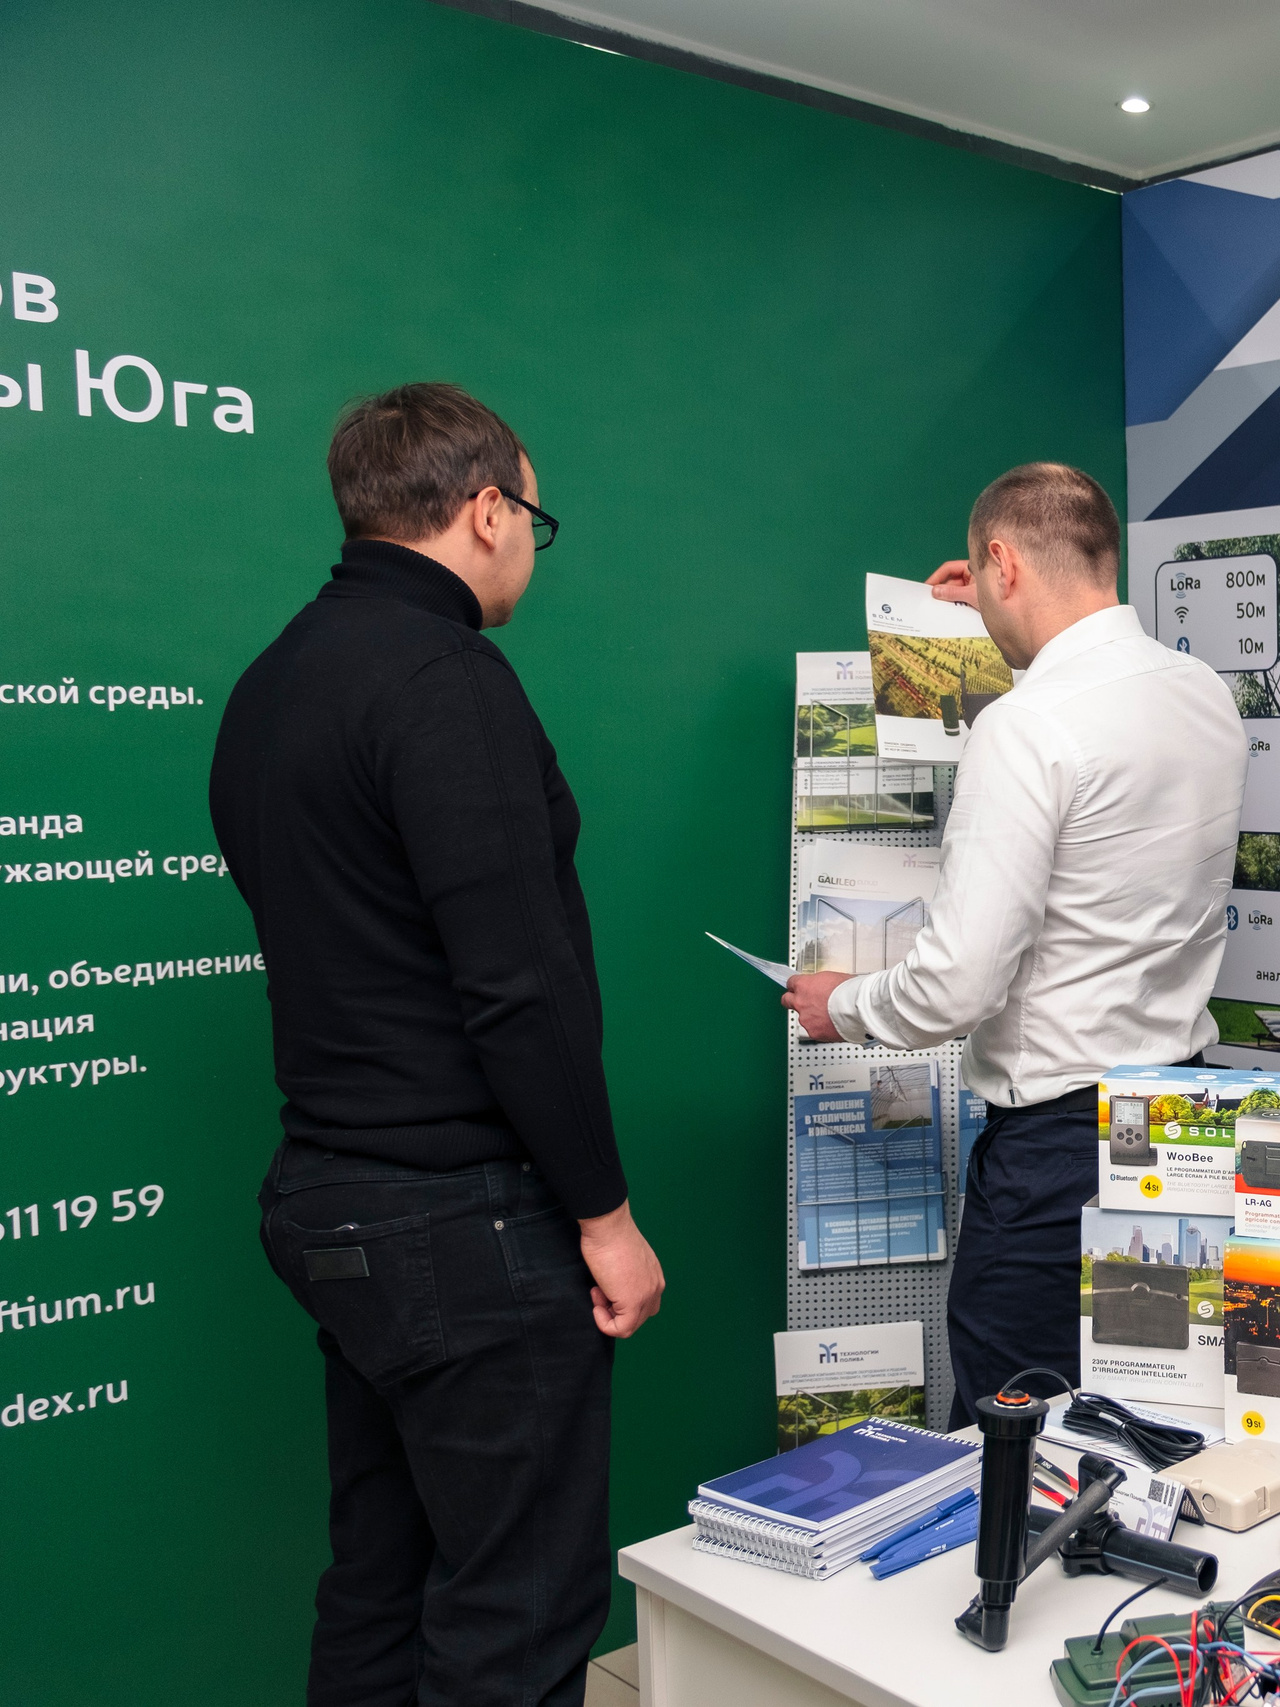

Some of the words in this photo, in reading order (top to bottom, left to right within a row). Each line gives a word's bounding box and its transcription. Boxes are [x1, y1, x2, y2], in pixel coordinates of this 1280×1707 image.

[76, 349, 254, 434] Юга
[1171, 576, 1200, 591] LoRa
[1226, 570, 1266, 588] 800м
[1236, 602, 1265, 619] 50м
[1238, 638, 1264, 654] 10м
[0, 677, 79, 705] ской
[89, 683, 204, 711] среды.
[0, 813, 83, 840] анда
[0, 850, 153, 883] жающей
[818, 875, 856, 887] GALILEO
[1248, 914, 1273, 925] LoRa
[48, 952, 267, 989] объединение
[818, 1099, 865, 1111] ОРОШЕНИЕ
[812, 1111, 866, 1124] ТЕПЛИЧНЫХ
[1166, 1151, 1214, 1163] WooBee
[53, 1195, 98, 1232] 19
[112, 1184, 165, 1223] 59
[1245, 1198, 1272, 1207] LR-AG
[1245, 1217, 1268, 1225] agricole
[1092, 1358, 1108, 1366] 230V
[1110, 1360, 1176, 1371] PROGRAMMATEUR
[1092, 1366, 1140, 1376] D'IRRIGATION
[1141, 1370, 1188, 1379] INTELLIGENT
[0, 1380, 128, 1427] dex.ru
